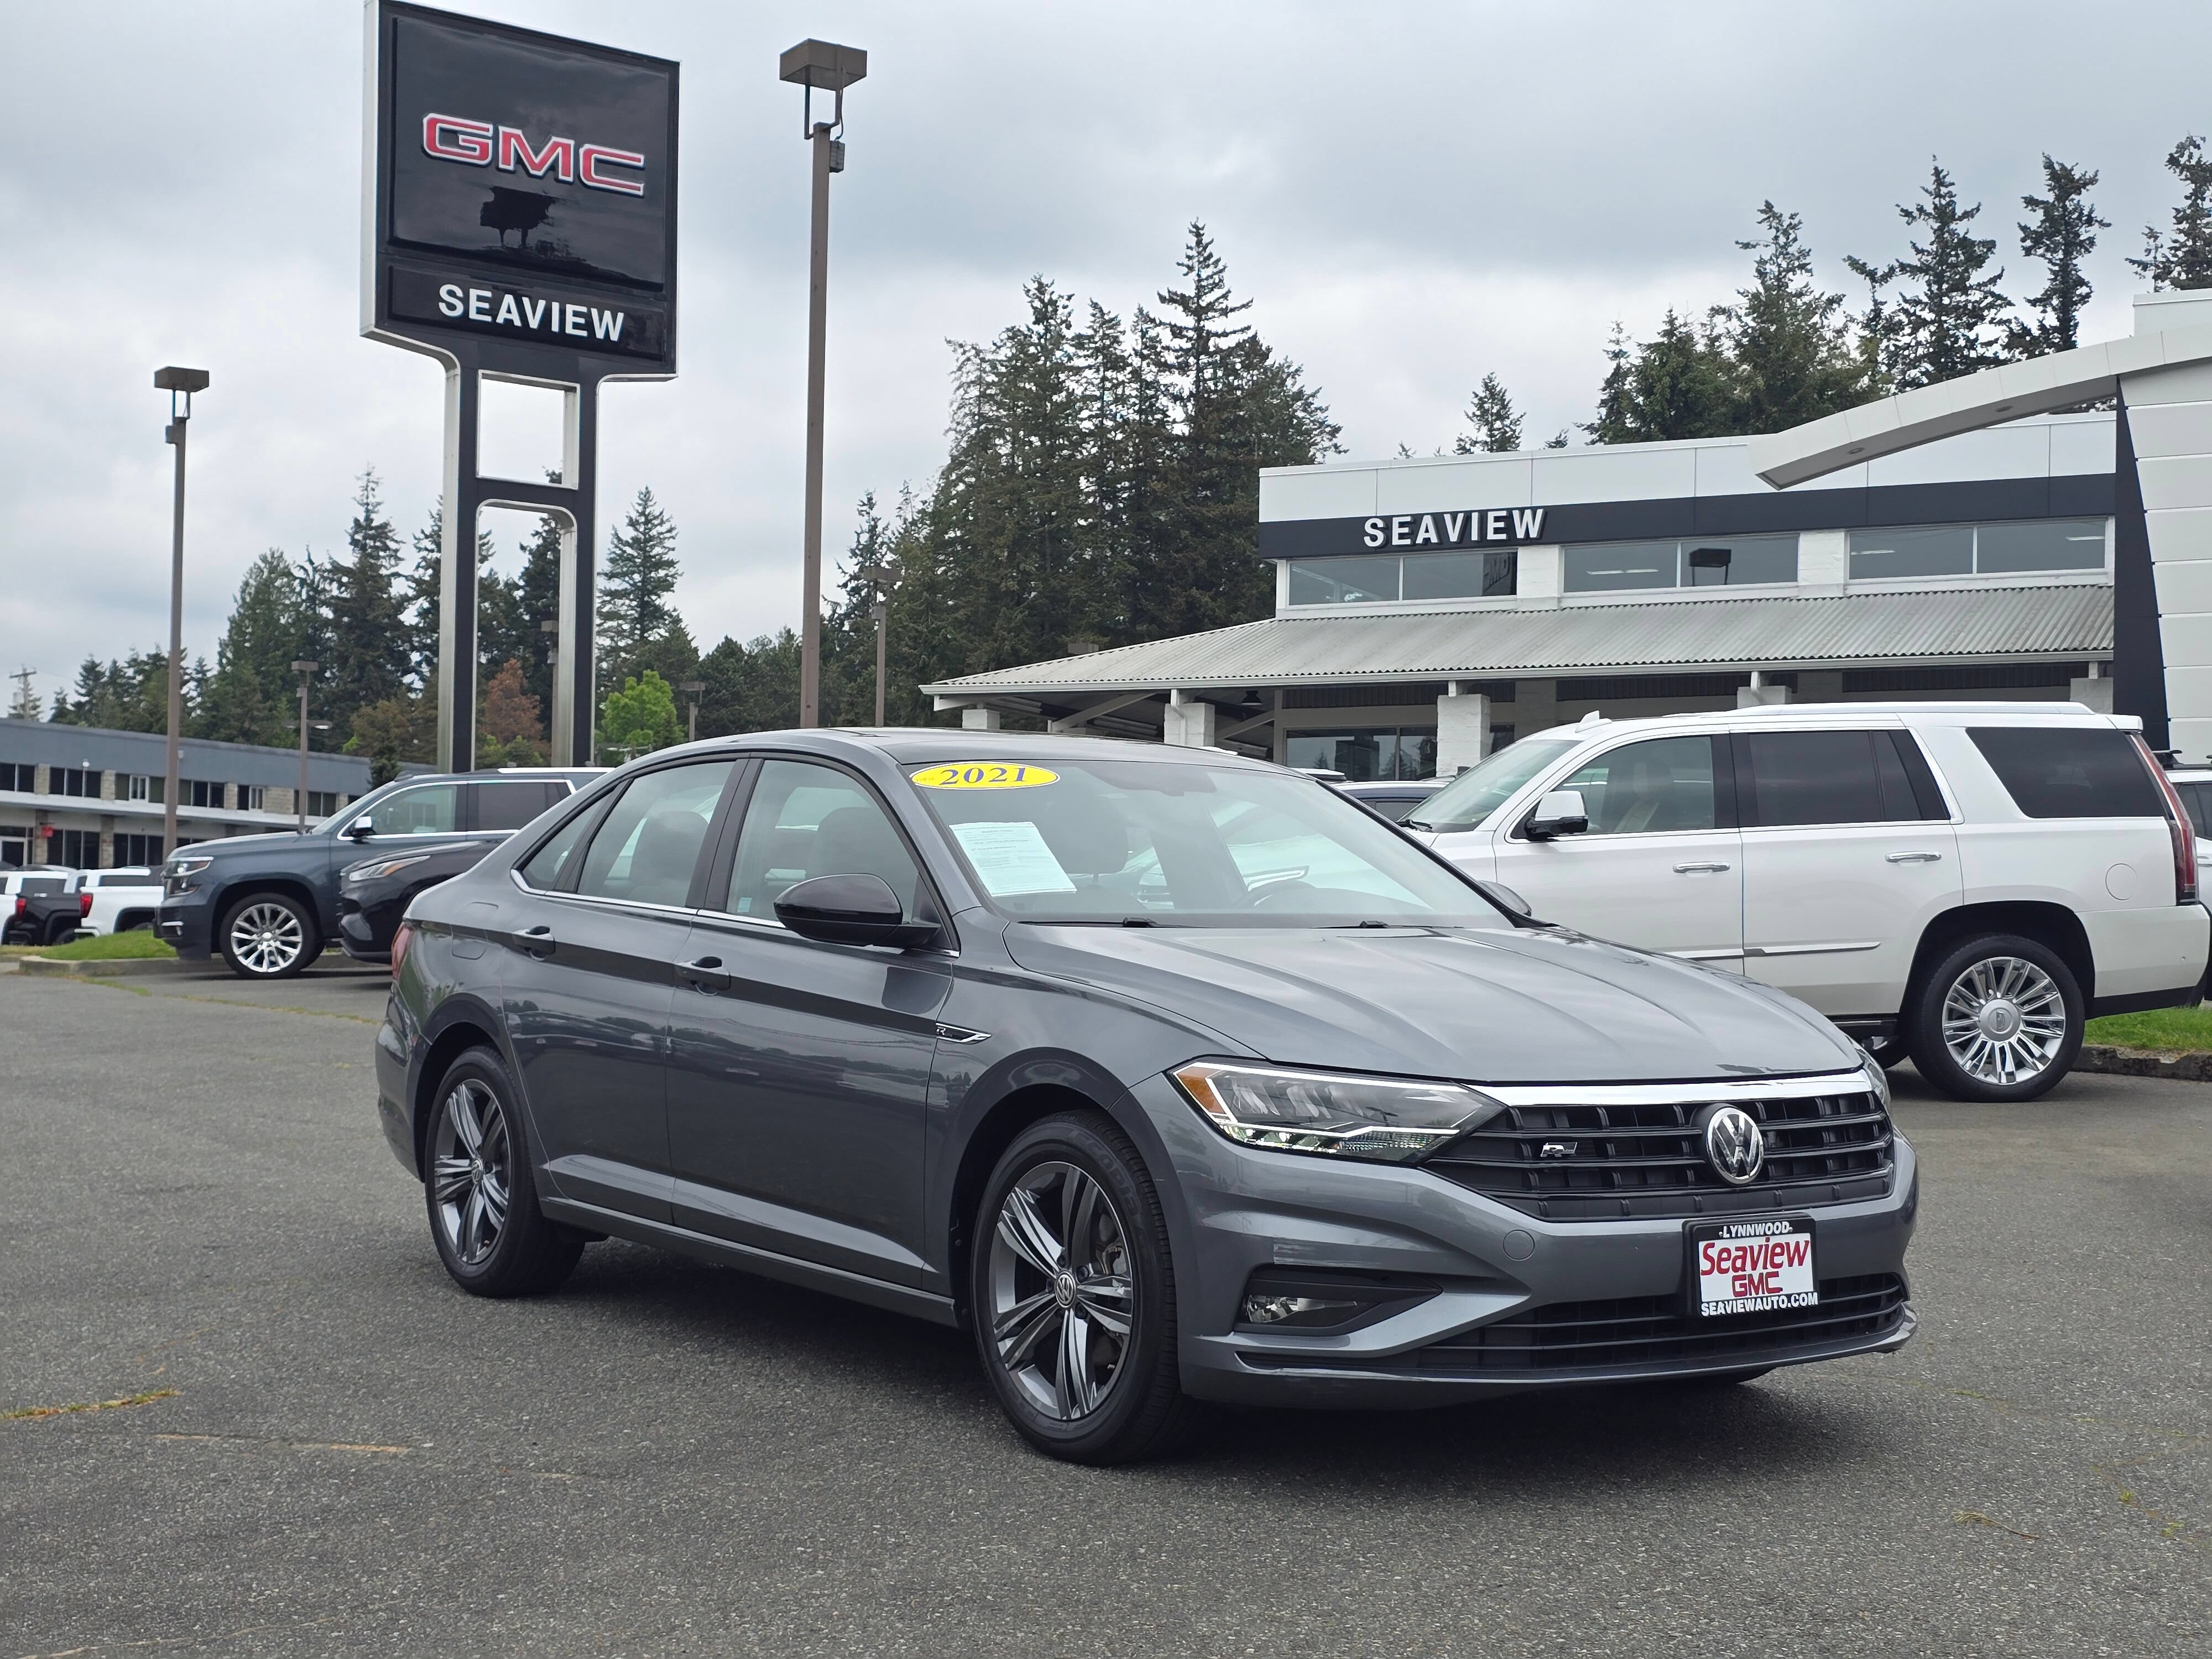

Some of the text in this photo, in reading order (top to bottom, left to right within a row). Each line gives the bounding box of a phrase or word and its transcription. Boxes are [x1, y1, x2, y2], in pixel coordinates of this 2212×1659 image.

[422, 112, 645, 197] GMC
[438, 284, 624, 342] SEAVIEW
[1363, 508, 1545, 547] SEAVIEW
[938, 767, 1027, 786] 2021
[1723, 1221, 1790, 1238] LYNNWOOD
[1700, 1237, 1810, 1276] Seaview
[1731, 1271, 1783, 1297] GMC
[1701, 1292, 1819, 1317] SEAVIEWAUTO.COM
